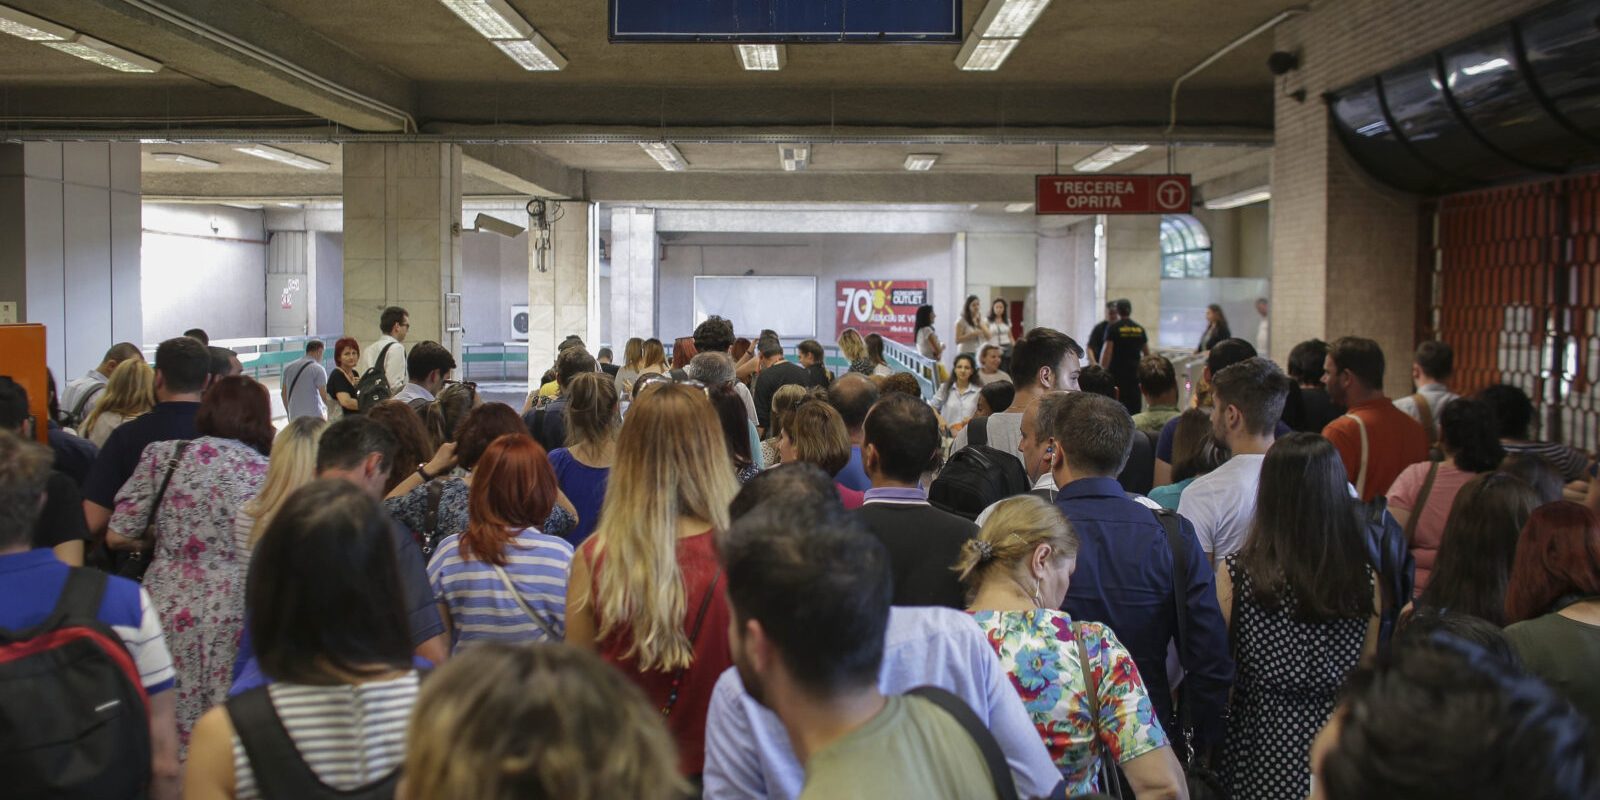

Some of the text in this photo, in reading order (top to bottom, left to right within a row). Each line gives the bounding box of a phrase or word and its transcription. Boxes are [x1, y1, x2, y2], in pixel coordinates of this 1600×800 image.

[1054, 181, 1135, 194] TRECEREA
[1066, 195, 1122, 208] OPRITA
[892, 295, 923, 305] OUTLET
